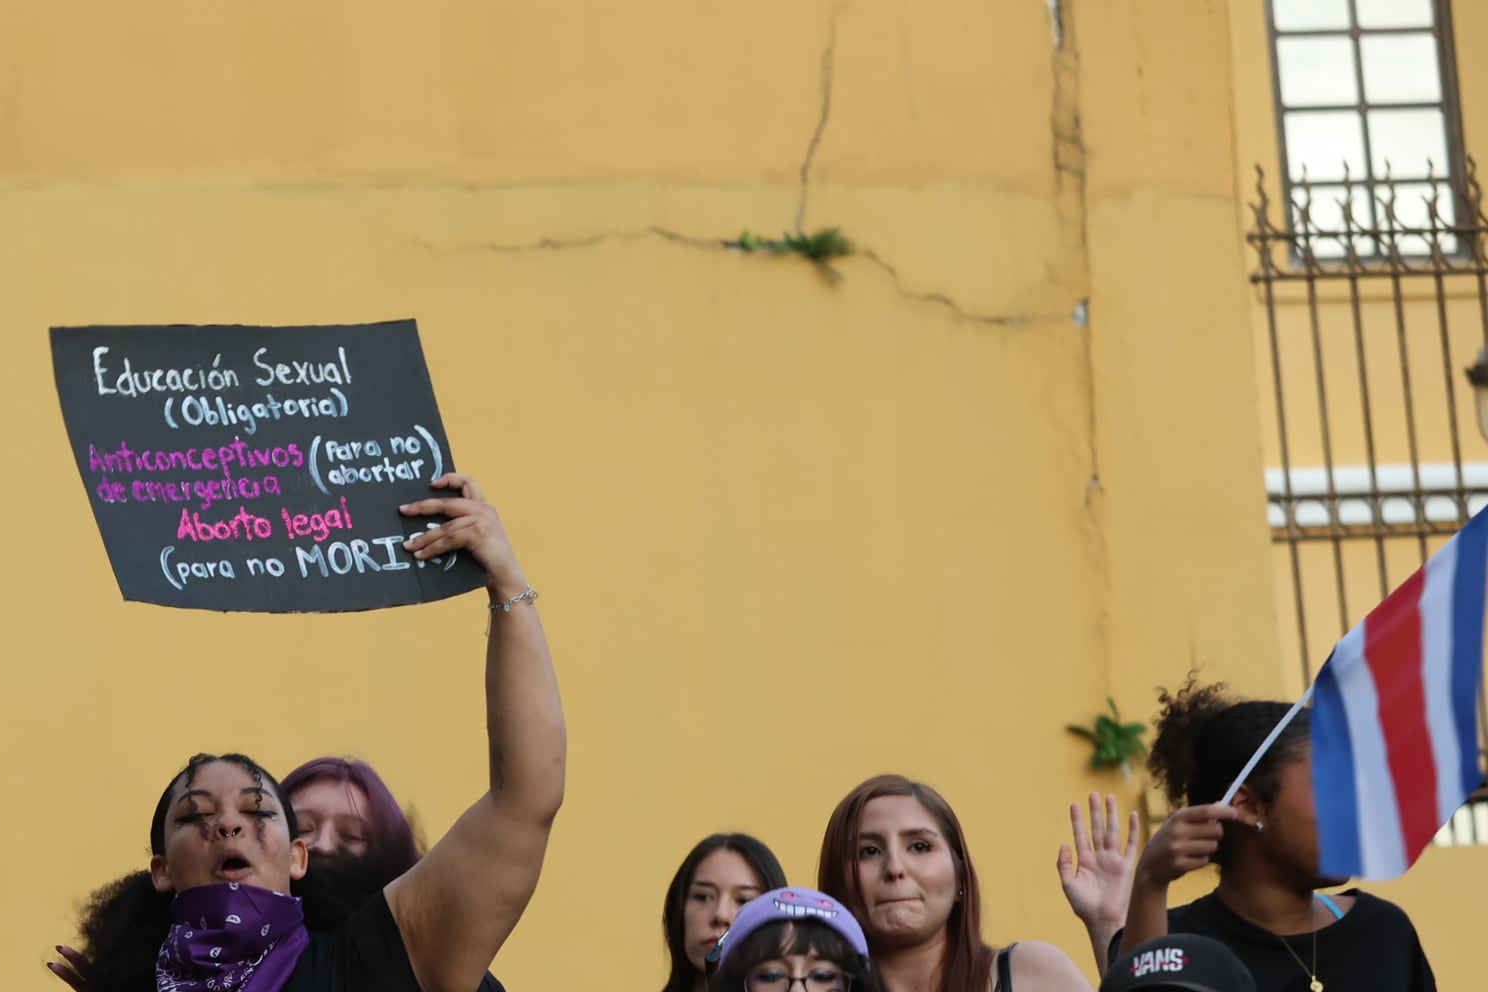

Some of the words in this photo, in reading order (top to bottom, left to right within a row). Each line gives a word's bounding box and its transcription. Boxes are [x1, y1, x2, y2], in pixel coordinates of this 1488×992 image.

[92, 346, 239, 397] Educación
[252, 346, 352, 386] Sexual
[164, 388, 349, 435] (Obligatoria)
[88, 436, 304, 473] Anticonceptivos
[390, 438, 421, 455] no
[96, 476, 126, 503] de
[131, 475, 282, 509] emergencia
[176, 507, 272, 542] Aborto
[281, 495, 353, 540] legal
[160, 545, 235, 590] (para
[247, 553, 285, 578] no
[1133, 948, 1184, 977] VANS
